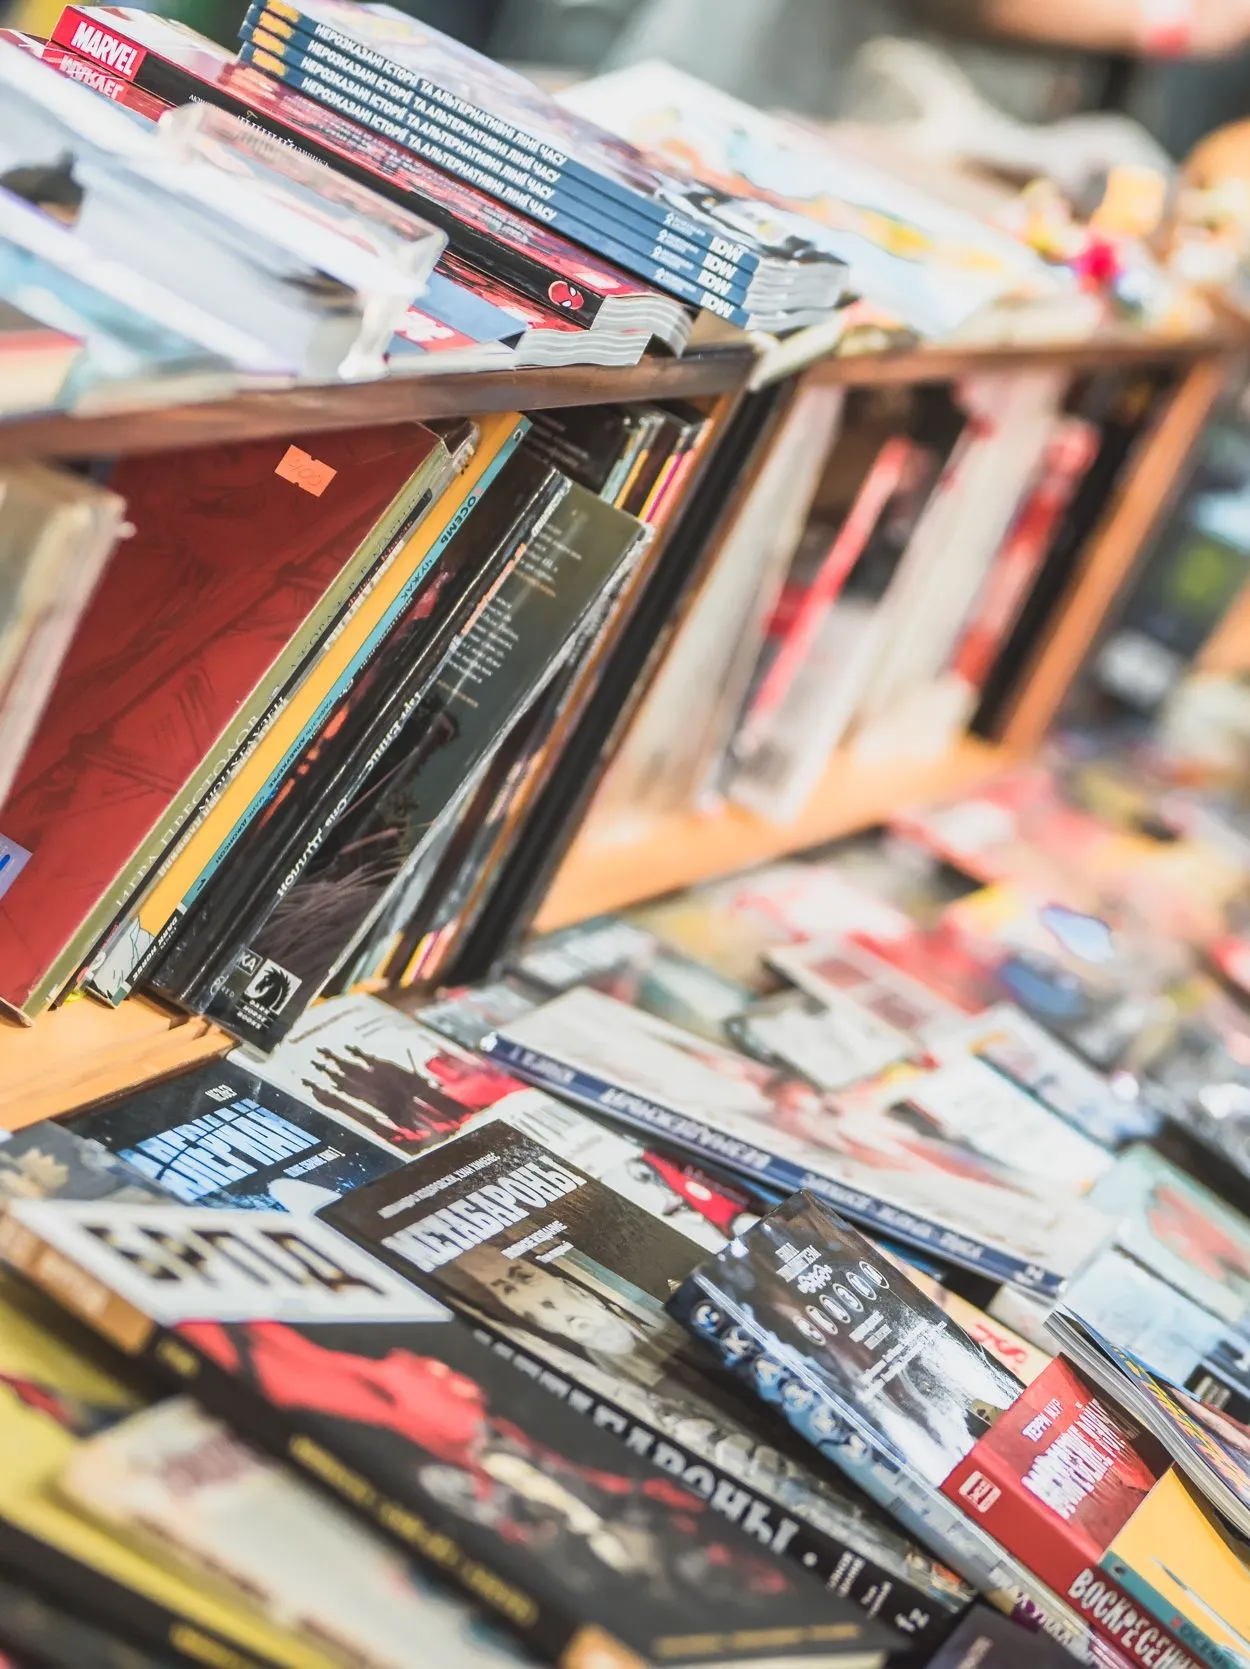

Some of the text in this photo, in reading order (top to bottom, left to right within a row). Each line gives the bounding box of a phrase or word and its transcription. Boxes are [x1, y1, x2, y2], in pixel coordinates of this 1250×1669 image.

[70, 21, 139, 76] MARVEL
[307, 40, 561, 183] НЕРОЗКАЗАНІ ІСТОРІЇ ТА АЛЬТЕРНАТИВНІ ЛІНІЇ ЧАСУ
[314, 24, 567, 167] НЕРОЗКАЗАНІ ІСТОРІЇ ТА АЛЬТЕРНАТИВНІ ЛІНІЇ ЧАСУ
[300, 55, 555, 200] НЕРОЗКАЗАНІ ІСТОРІЇ ТА АЛЬТЕРНАТИВНІ ЛІНІЇ ЧАСУ
[301, 78, 557, 221] НЕРОЗКАЗАНІ ІСТОРІЇ ТА АЛЬТЕРНАТИВНІ ЛІНІЇ ЧАСУ
[702, 252, 739, 280] IDW
[709, 237, 745, 262] IDW
[696, 269, 733, 295] IDW
[700, 290, 735, 318] IDW
[401, 495, 477, 600] ОСЕМЬ ЧУЖАК
[266, 736, 306, 789] АЛЬБУКЕРКЕ
[115, 854, 159, 907] ИГРА
[160, 714, 260, 846] ПРЕСТОЛОВ
[213, 819, 249, 865] ДЖОНСОН
[129, 915, 181, 982] DARK HORSE
[237, 1010, 261, 1029] BOOKS
[243, 1005, 267, 1023] HORSE
[249, 999, 270, 1015] DARK
[381, 1155, 588, 1273] МЕТАБАРОНЫ
[1022, 1397, 1063, 1442] ТЕРРИ МУР
